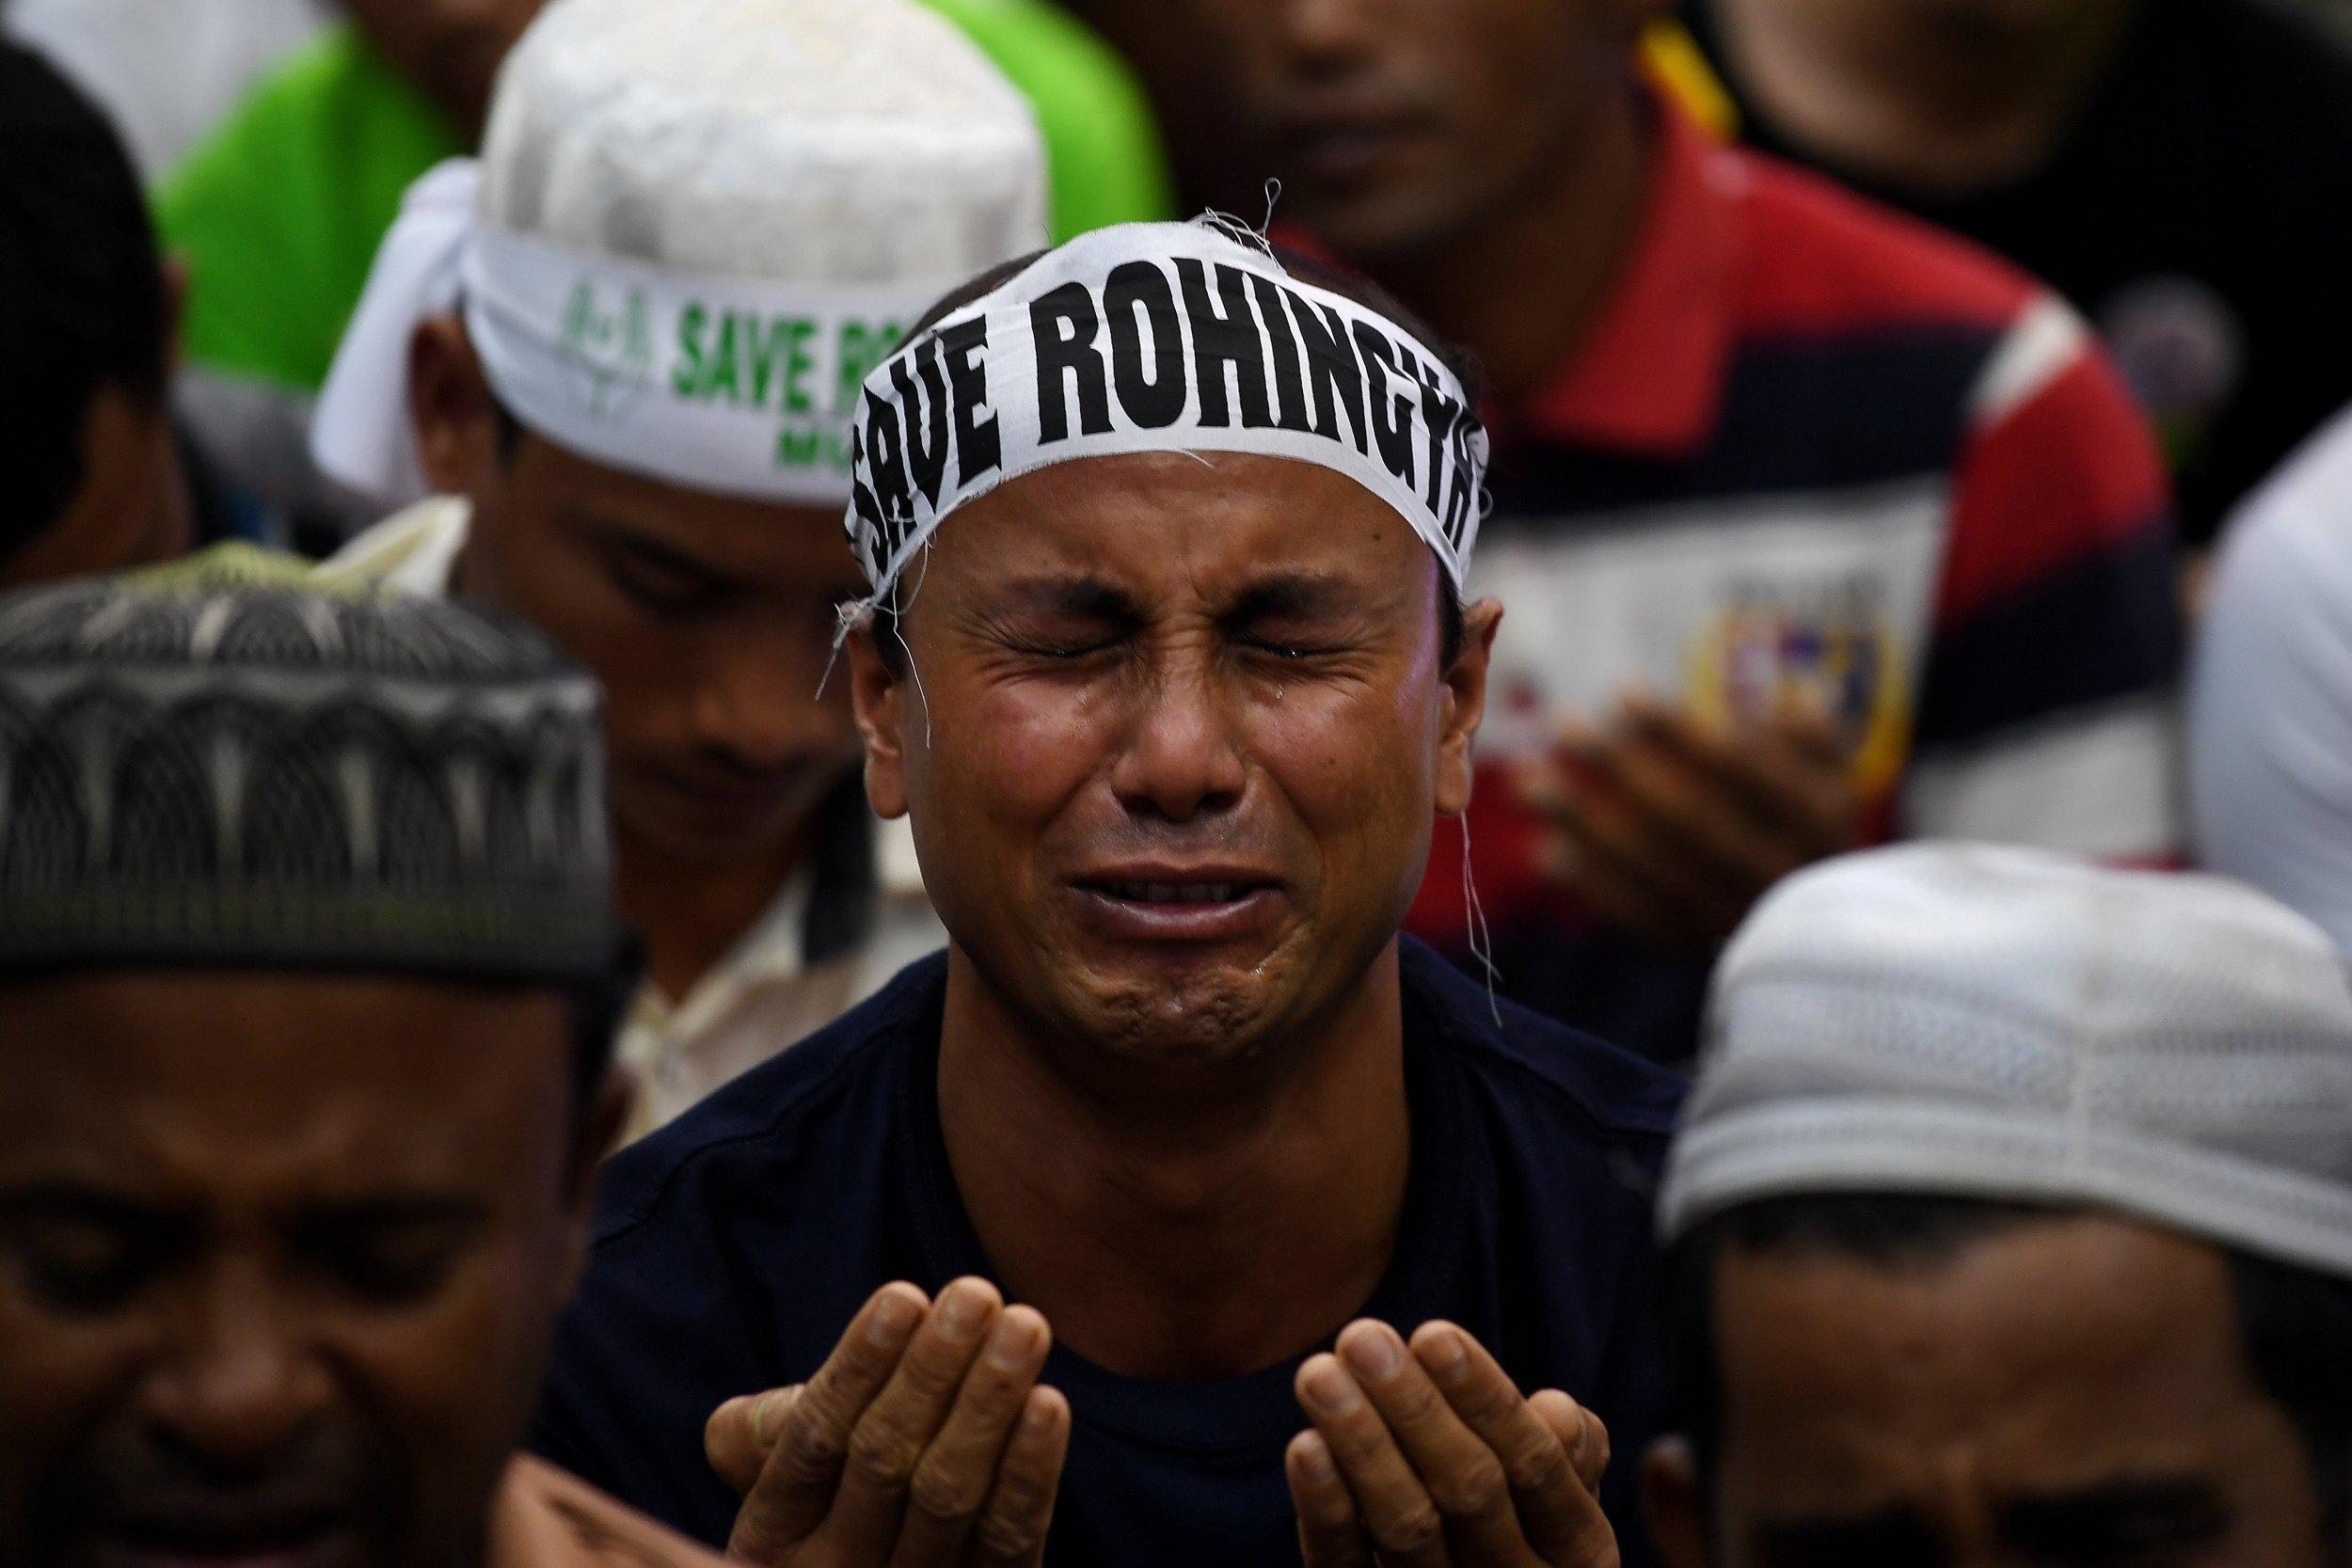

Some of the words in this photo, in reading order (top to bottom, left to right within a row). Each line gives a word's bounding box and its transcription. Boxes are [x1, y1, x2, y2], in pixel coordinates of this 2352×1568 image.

[672, 299, 816, 415] SAVE
[844, 313, 1002, 578] SAVE
[1030, 257, 1484, 554] ROHINGYA
